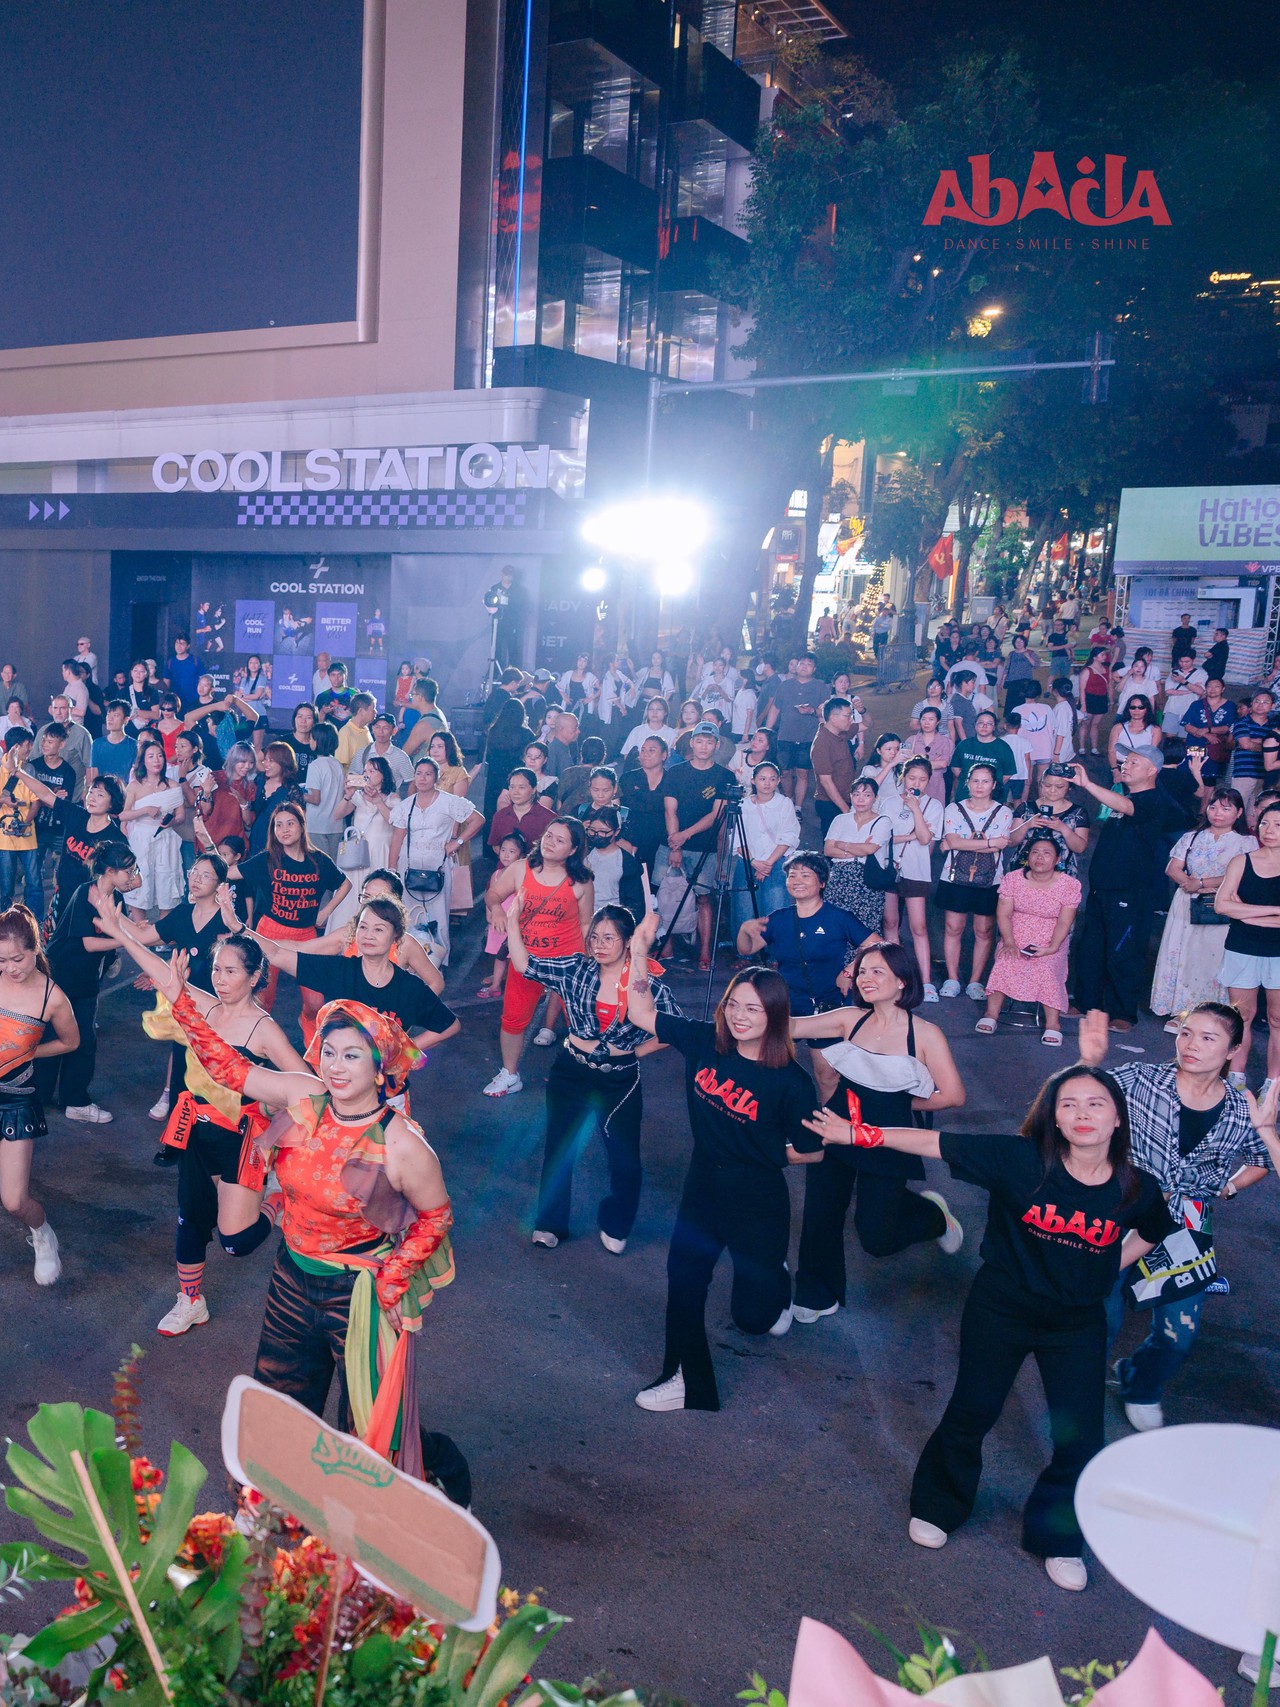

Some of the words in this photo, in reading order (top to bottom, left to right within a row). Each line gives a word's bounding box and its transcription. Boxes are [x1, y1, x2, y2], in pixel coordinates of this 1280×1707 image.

[270, 582, 307, 594] COOL
[308, 583, 365, 595] STATION
[244, 618, 265, 627] COOL
[321, 617, 352, 626] BETTER
[246, 626, 262, 635] RUN
[271, 903, 300, 921] Soul.
[1027, 1226, 1052, 1241] DANCE
[1056, 1237, 1084, 1250] SMILE
